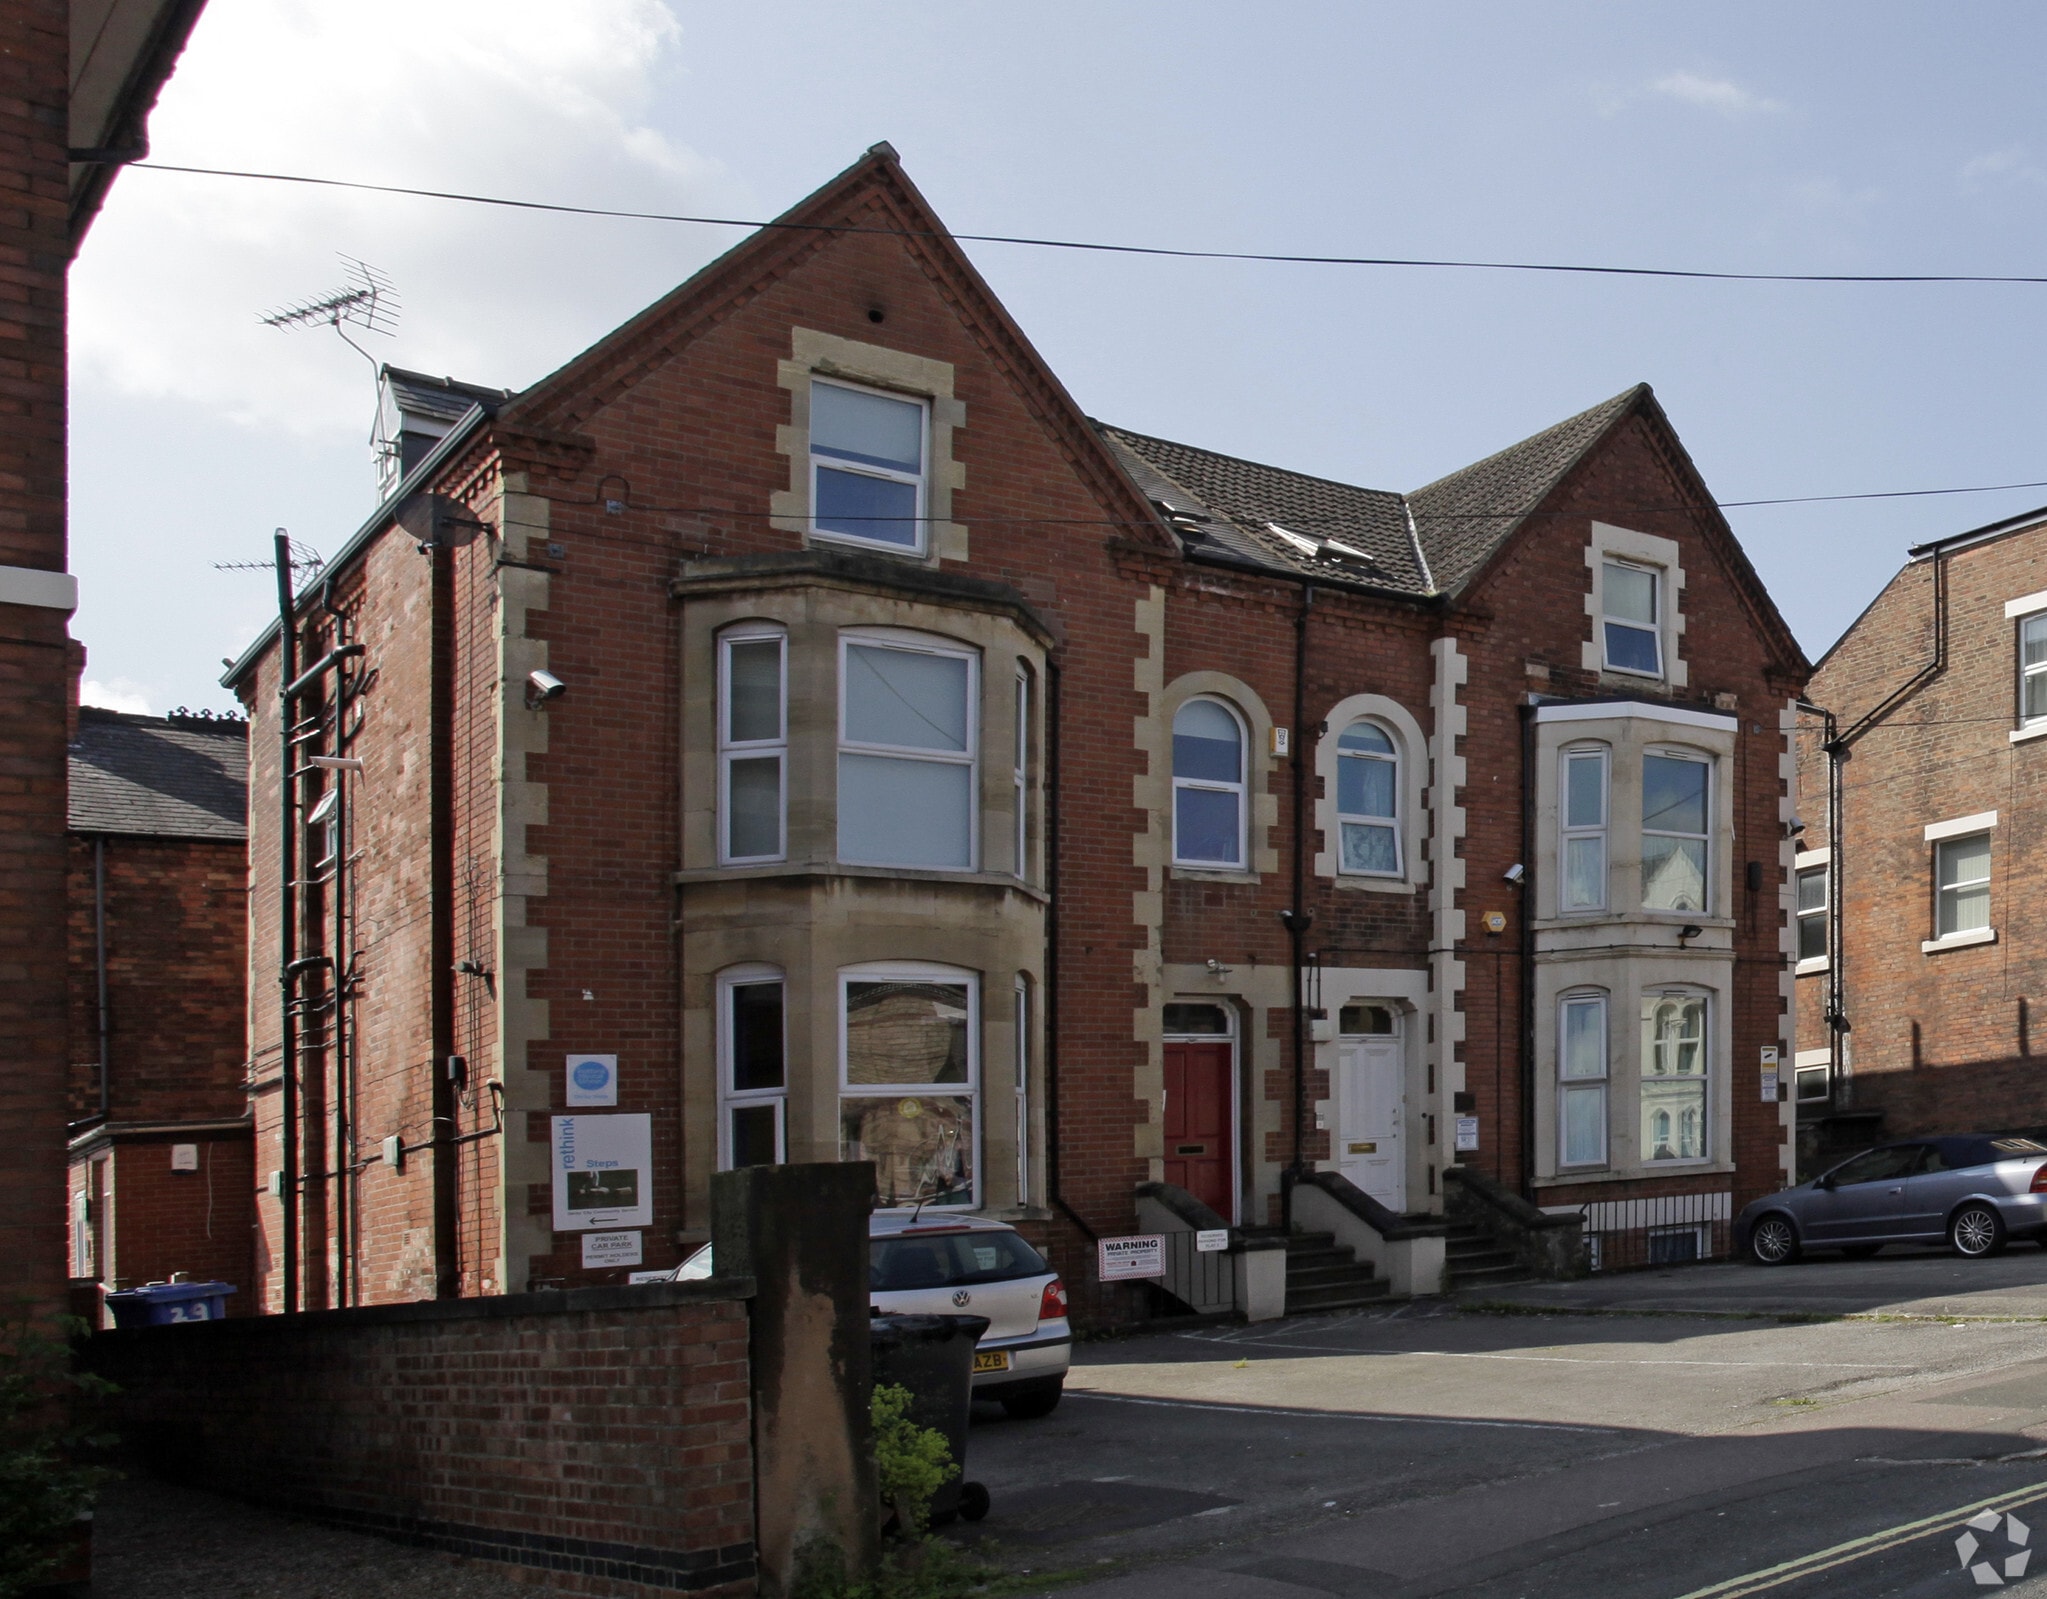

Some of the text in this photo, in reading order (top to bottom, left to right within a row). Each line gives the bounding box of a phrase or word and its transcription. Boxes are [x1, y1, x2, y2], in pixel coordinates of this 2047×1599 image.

[559, 1117, 575, 1169] rethink
[586, 1159, 619, 1169] Steps
[1105, 1239, 1158, 1251] WARNING
[170, 1303, 208, 1323] 29
[974, 1353, 1003, 1369] AZB
